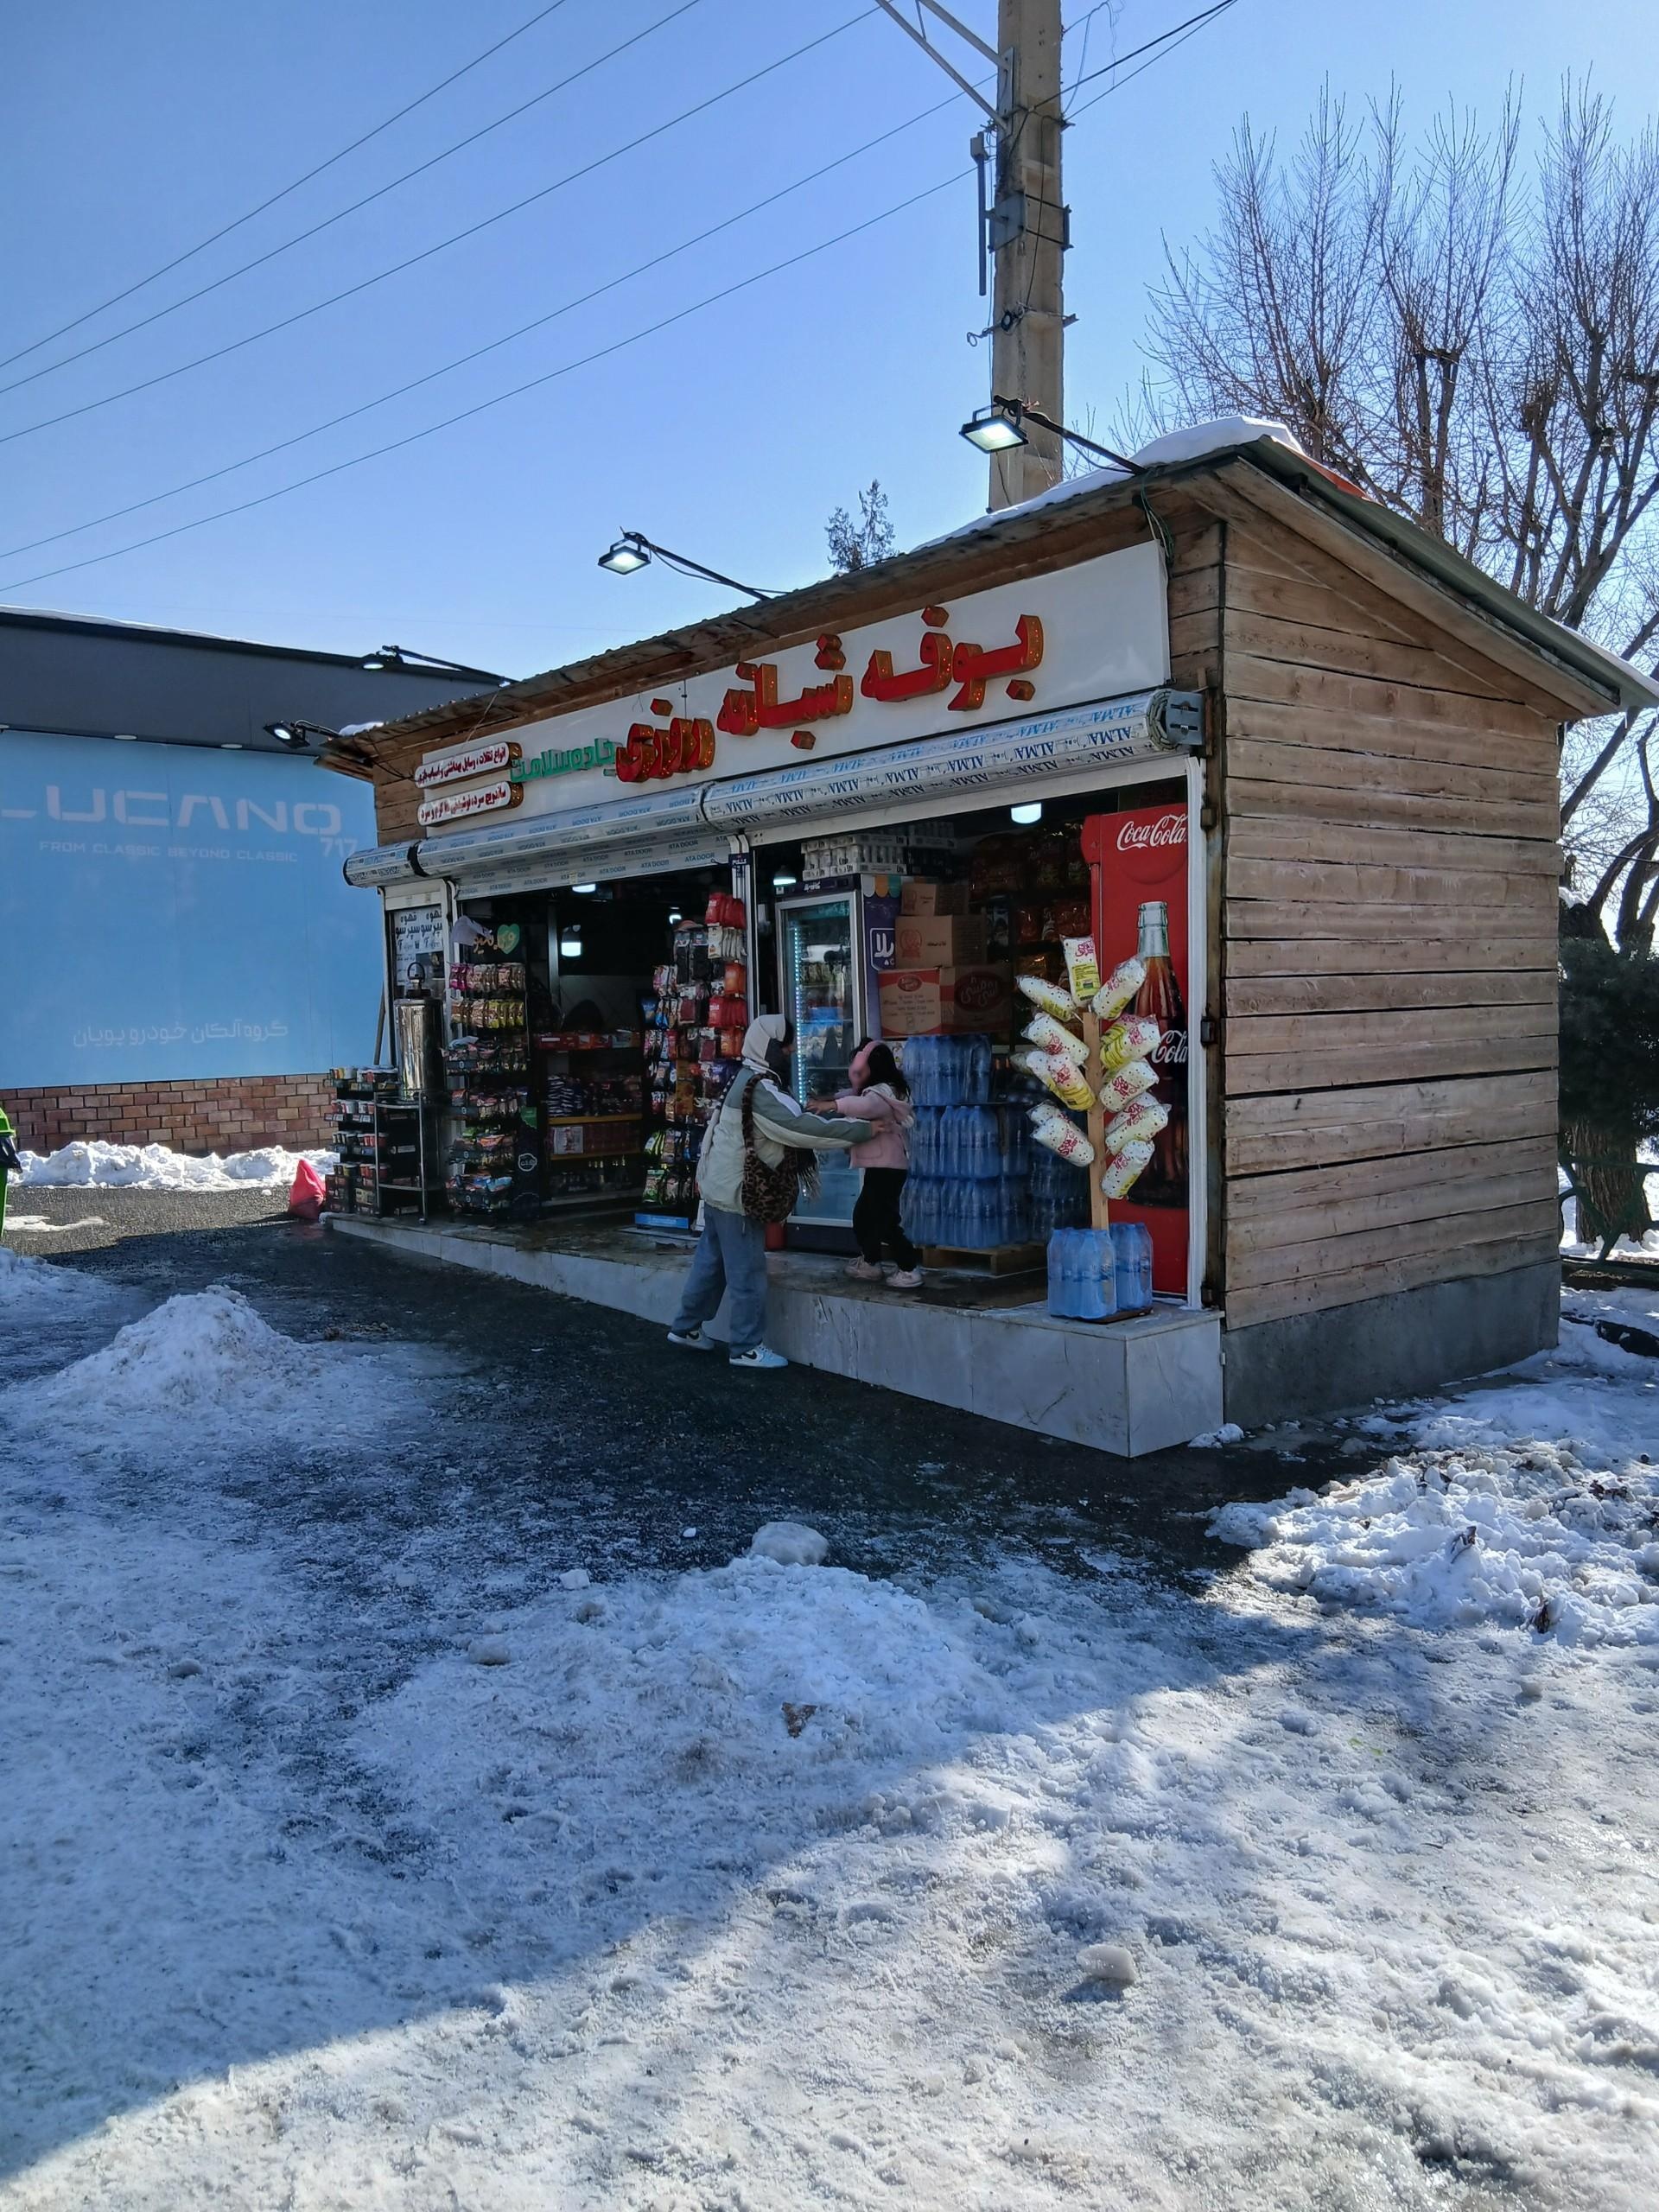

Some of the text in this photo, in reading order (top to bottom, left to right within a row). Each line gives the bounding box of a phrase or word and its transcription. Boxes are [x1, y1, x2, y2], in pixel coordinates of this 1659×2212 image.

[615, 606, 1044, 781] بوفه شبانه روزی
[1014, 741, 1056, 760] ALMA
[1117, 813, 1188, 850] Coca-Cola
[39, 841, 297, 862] FROM CLASSIC BEYOND CLASSIC
